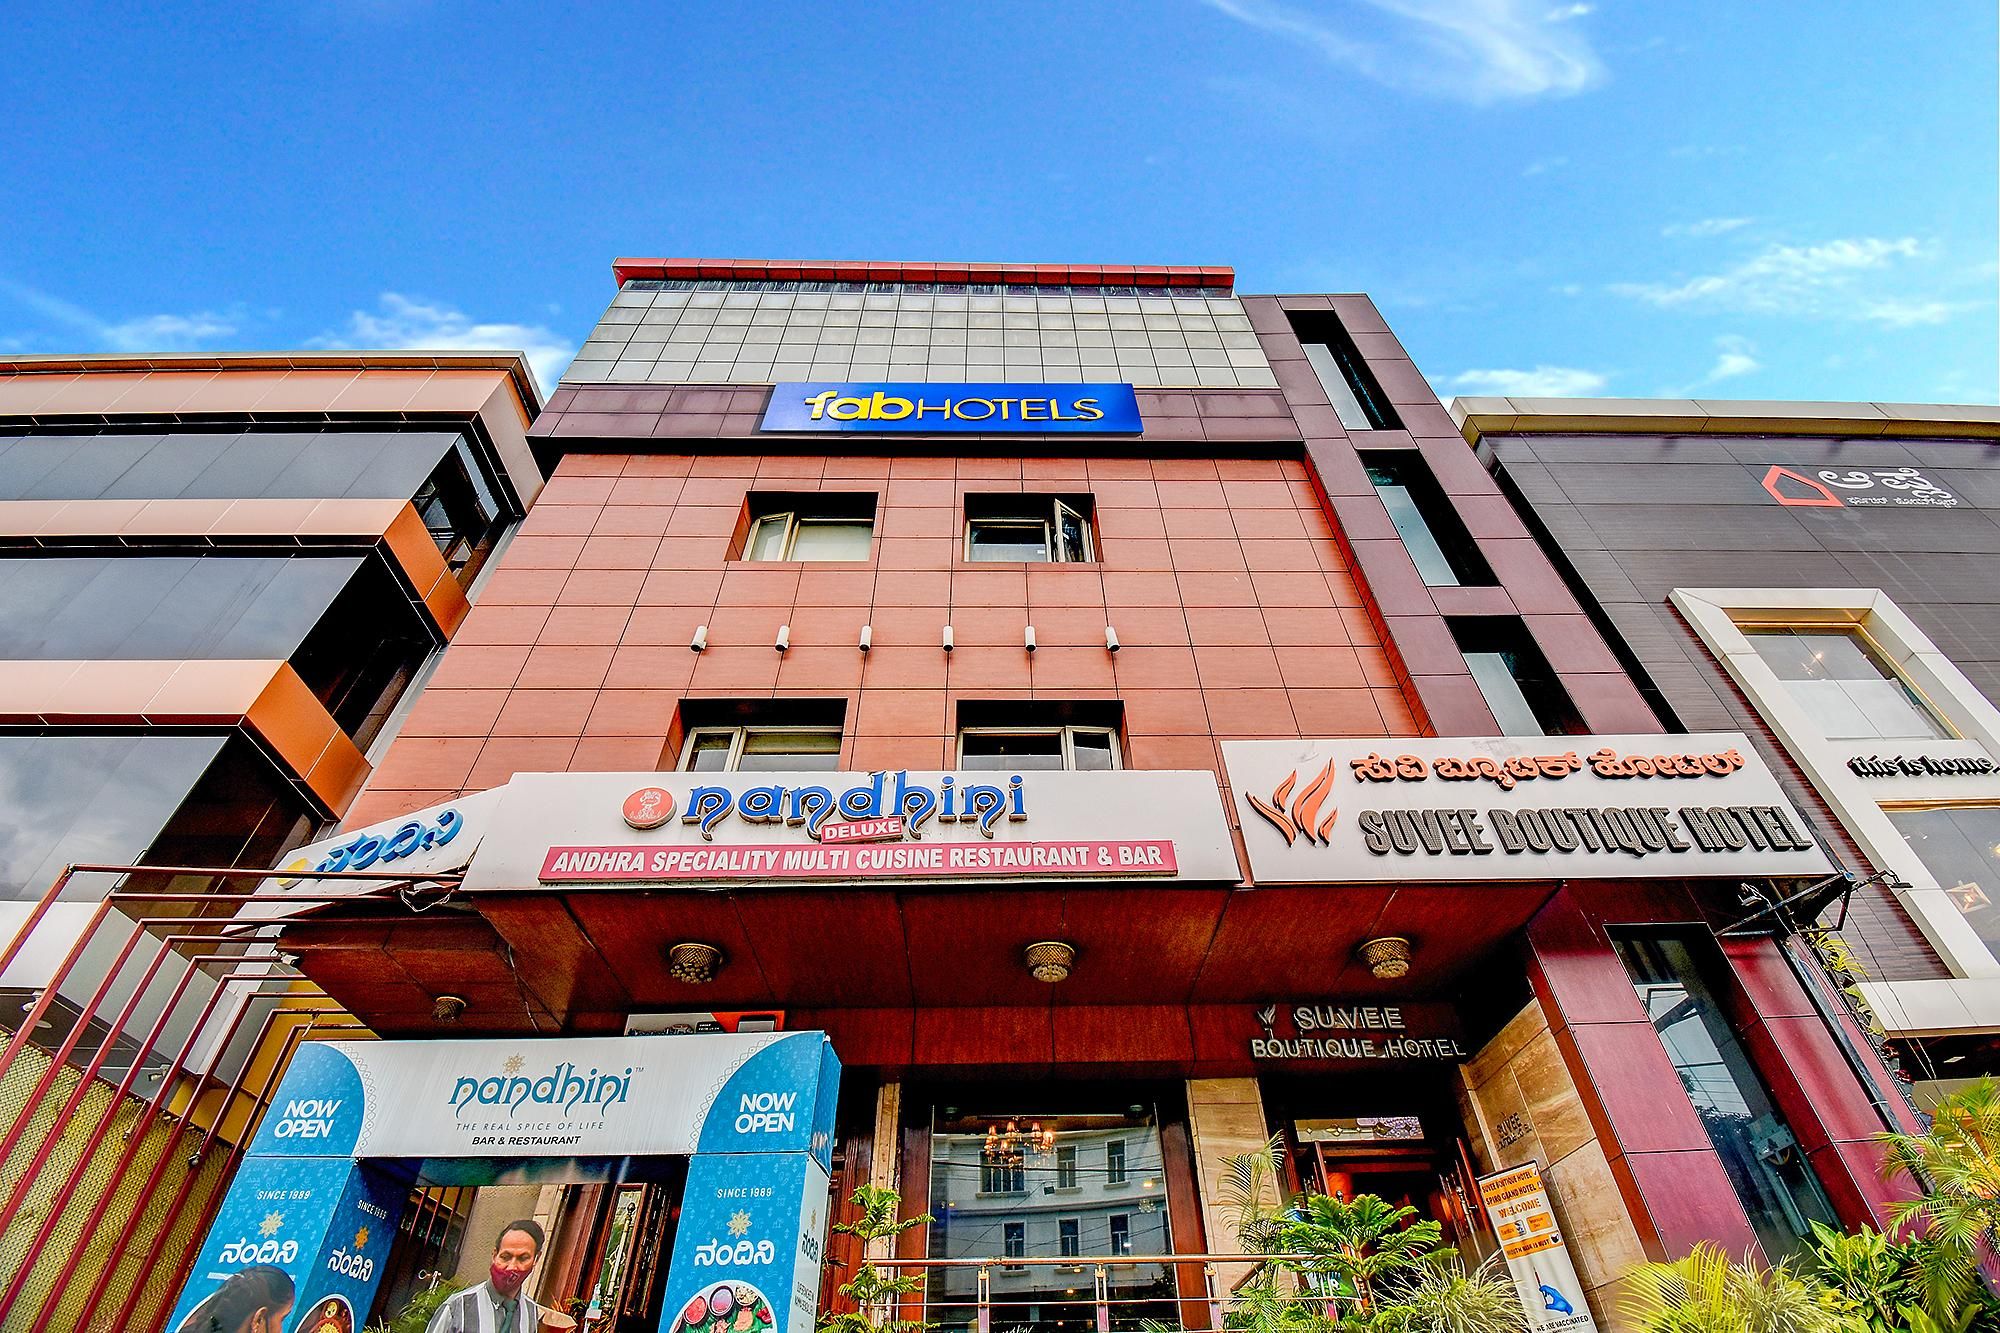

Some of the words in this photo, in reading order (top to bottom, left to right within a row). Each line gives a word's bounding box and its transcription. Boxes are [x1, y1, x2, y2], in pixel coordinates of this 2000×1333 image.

[1350, 751, 1429, 783] ಸುವಿ
[1847, 754, 1900, 778] this
[681, 768, 1028, 842] nandhini
[825, 820, 901, 840] DELUXE
[1358, 808, 1495, 856] SUVEE
[1488, 807, 1692, 857] BOUTIQUE
[1678, 806, 1814, 852] HOTEL
[550, 852, 645, 872] ANDHRA
[651, 850, 779, 872] SPECIALITY
[782, 850, 849, 870] MULTI
[856, 848, 943, 869] CUISINE
[950, 846, 1090, 868] RESTAURANT
[1097, 846, 1112, 866] &
[1119, 845, 1163, 865] BAR
[1293, 1005, 1406, 1029] SUVEE
[1251, 1038, 1379, 1058] BOUTIQUE
[1384, 1038, 1467, 1058] HOTEL
[447, 1061, 633, 1119] nandhini
[283, 1099, 342, 1118] NOW
[739, 1092, 798, 1113] NOW
[274, 1119, 334, 1138] OPEN
[455, 1123, 478, 1131] THE
[482, 1122, 511, 1131] REAL
[516, 1122, 551, 1131] SPICE
[557, 1122, 573, 1130] OF
[578, 1121, 604, 1130] LIFE
[735, 1112, 795, 1134] OPEN
[472, 1136, 496, 1145] BAR
[497, 1136, 506, 1145] &
[508, 1135, 582, 1146] RESTAURANT
[256, 1190, 286, 1200] SINCE
[288, 1189, 312, 1200] 1989
[717, 1188, 747, 1199] SINCE
[749, 1187, 773, 1198] 1989
[1517, 1182, 1537, 1194] HOTEL
[357, 1199, 376, 1215] SINCE
[1497, 1197, 1542, 1219] WELCOME
[218, 1237, 299, 1265] ನಂದಿನಿ
[694, 1237, 776, 1267] ನಂದಿನಿ
[327, 1245, 375, 1282] ನಂದಿನಿ
